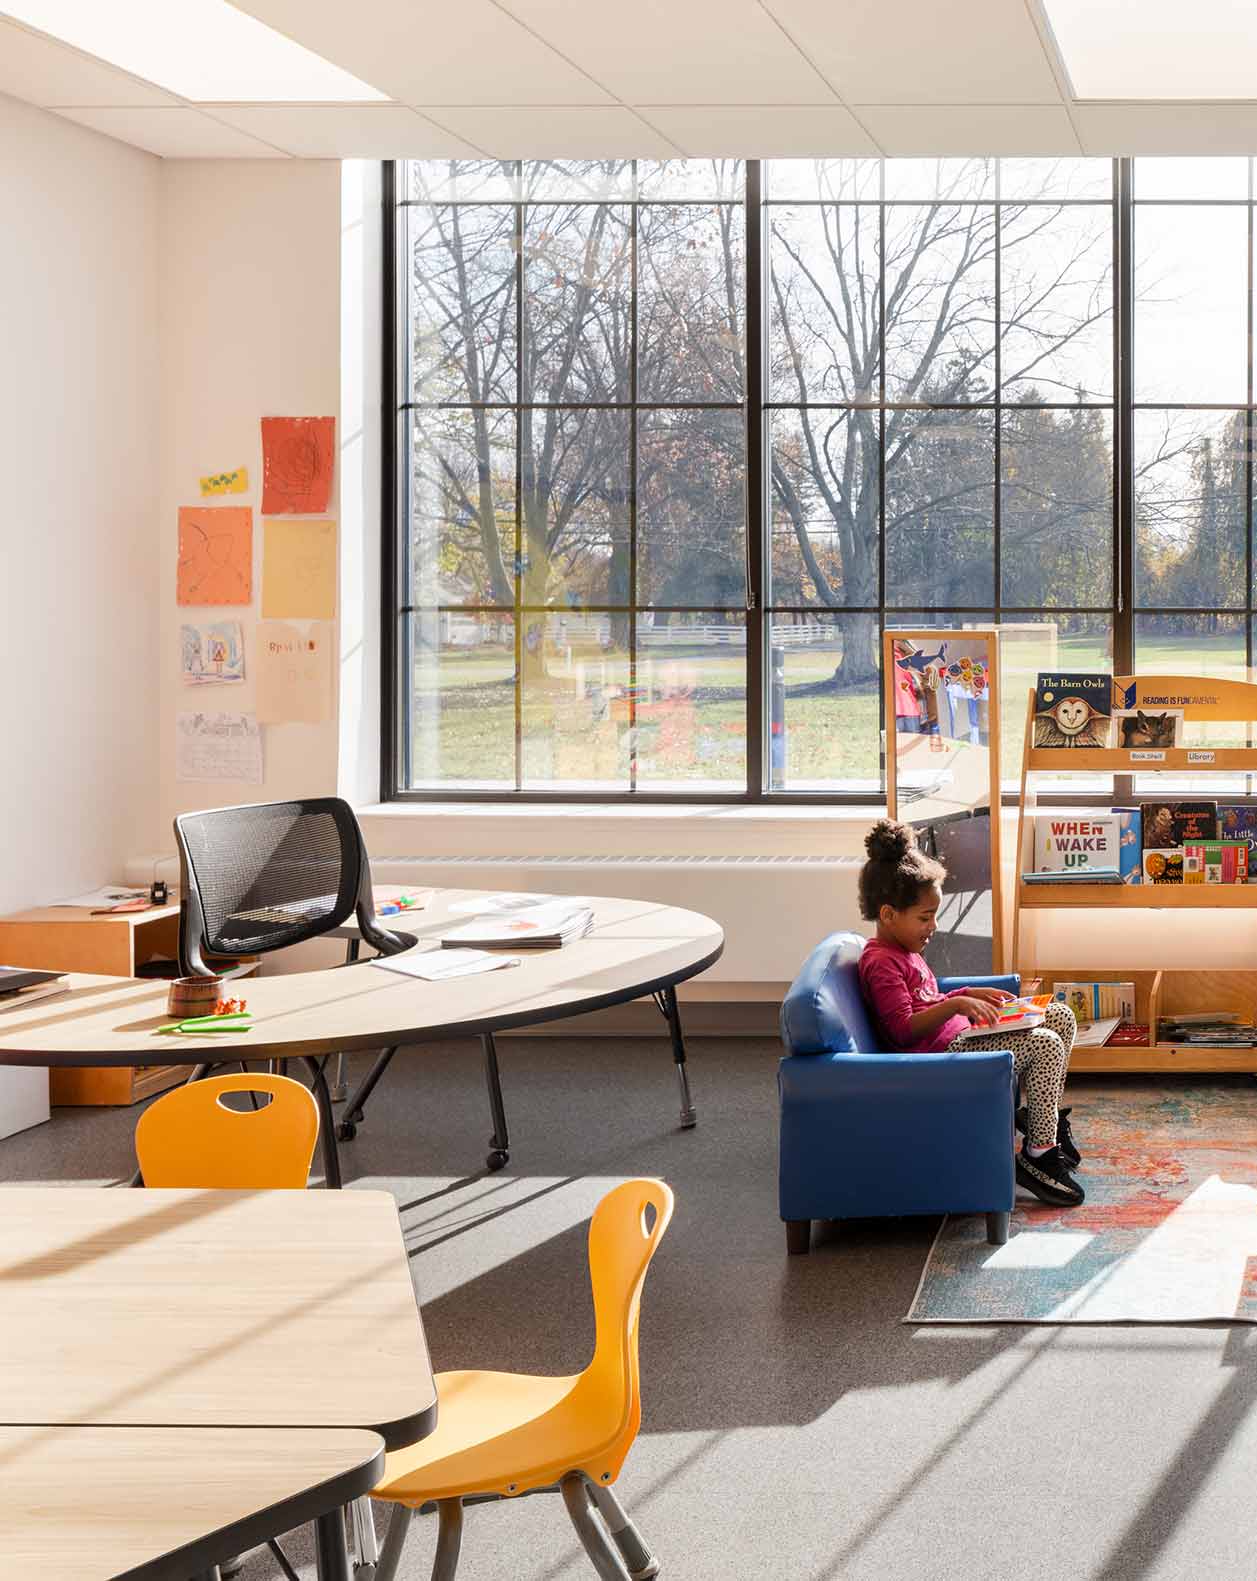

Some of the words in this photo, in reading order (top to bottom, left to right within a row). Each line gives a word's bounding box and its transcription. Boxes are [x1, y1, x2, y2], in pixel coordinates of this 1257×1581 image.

[1041, 677, 1059, 688] The
[1060, 679, 1081, 688] Barn
[1082, 679, 1105, 688] Owls
[1142, 696, 1168, 705] READING
[1169, 696, 1177, 705] IS
[1188, 751, 1215, 761] Library
[1234, 829, 1254, 839] Little
[1055, 838, 1106, 851] WAKE
[1064, 854, 1088, 867] UP
